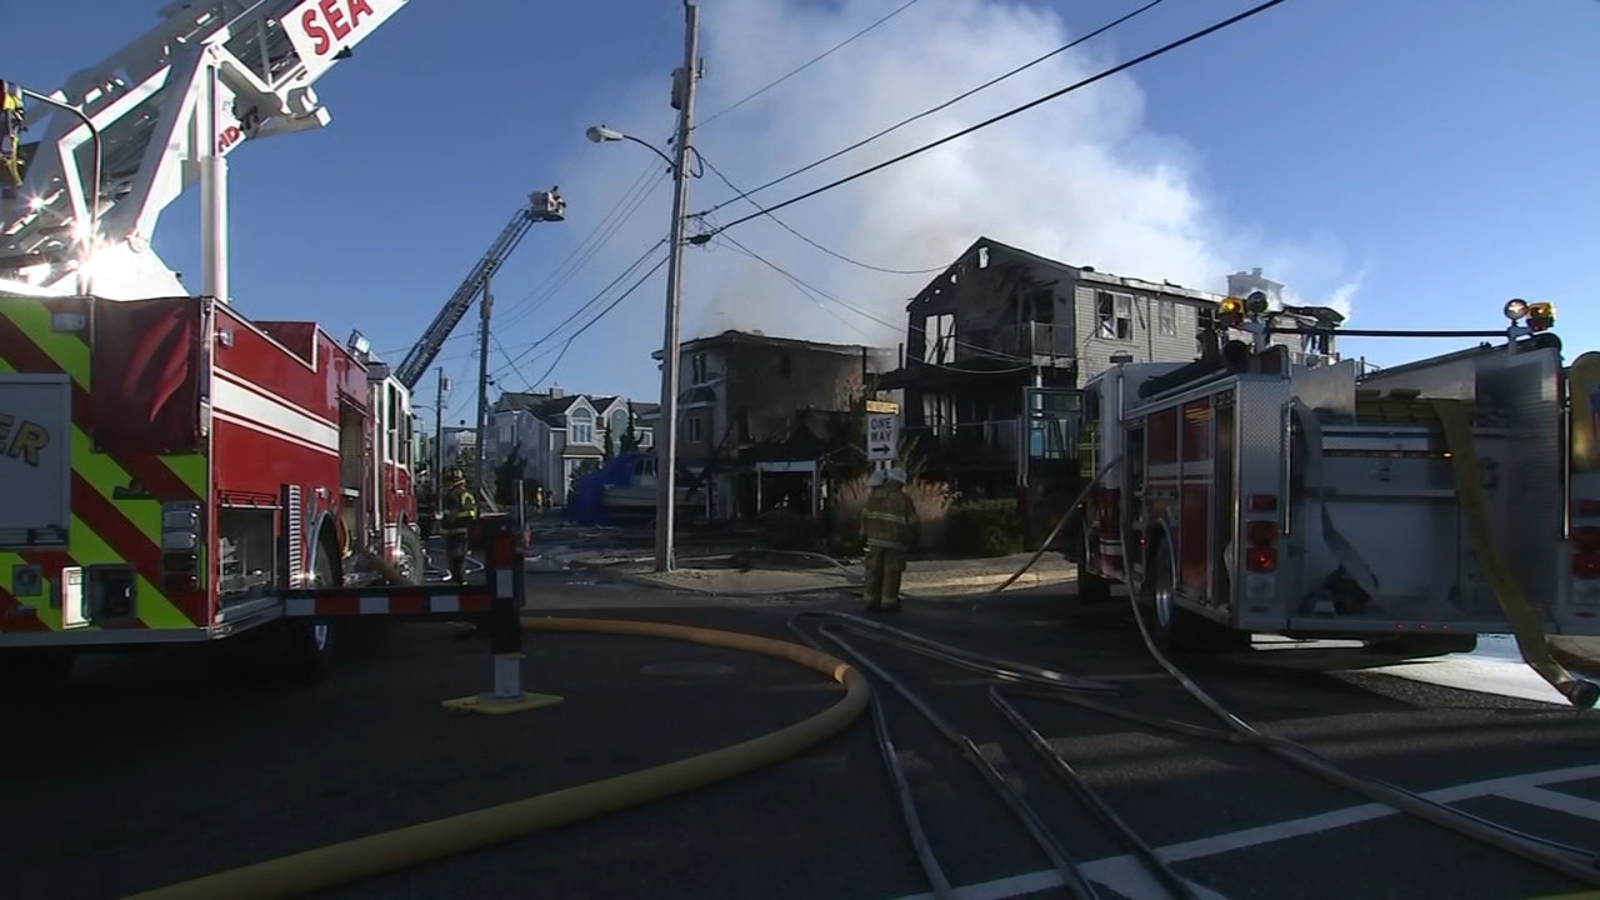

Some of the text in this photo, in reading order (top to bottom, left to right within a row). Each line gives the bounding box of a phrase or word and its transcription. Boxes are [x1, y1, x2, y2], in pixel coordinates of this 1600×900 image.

[302, 0, 374, 55] SEA
[871, 418, 892, 430] ONE
[871, 430, 892, 442] WAY
